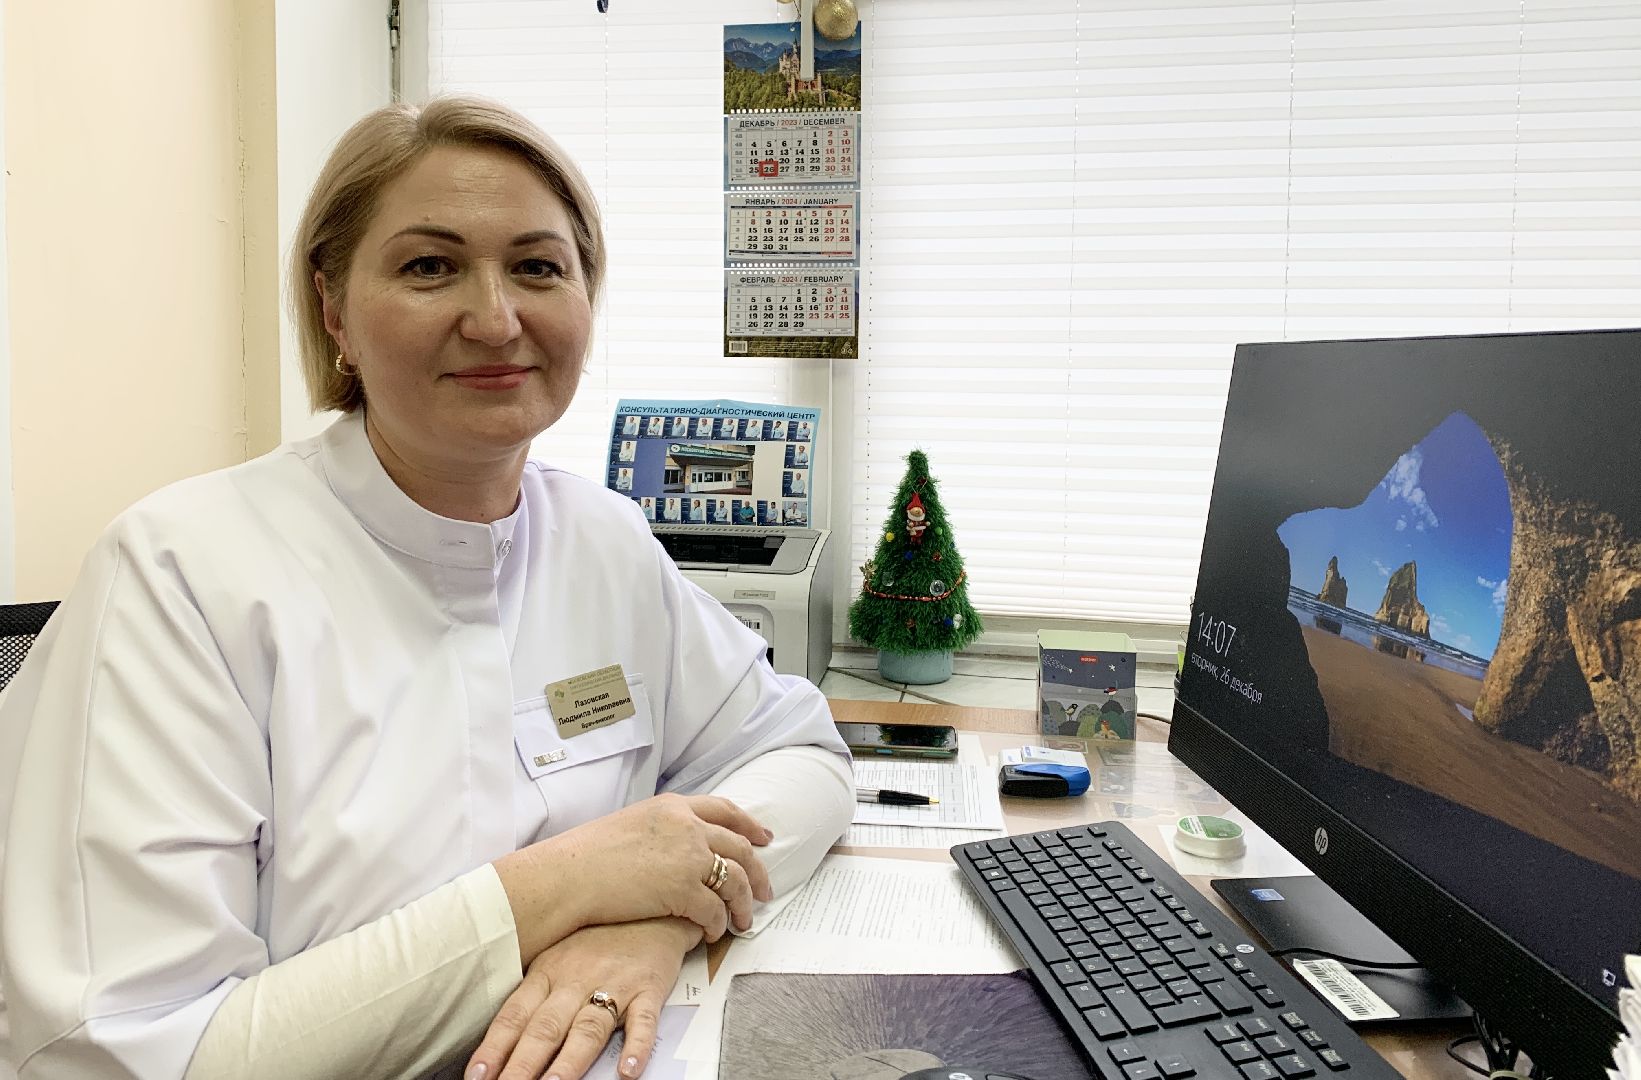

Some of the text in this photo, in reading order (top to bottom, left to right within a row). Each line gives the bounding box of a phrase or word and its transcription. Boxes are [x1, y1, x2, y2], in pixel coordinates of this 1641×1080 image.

[619, 406, 816, 420] КОНСУЛЬТАТИВНО-ДИАГНОСТИЧЕСКИЙ ЦЕНТР
[1198, 612, 1237, 657] 14:07
[1192, 653, 1262, 704] вторник, 26 декабря
[559, 697, 631, 725] Людмила Николаевна
[574, 692, 610, 708] Лазовская
